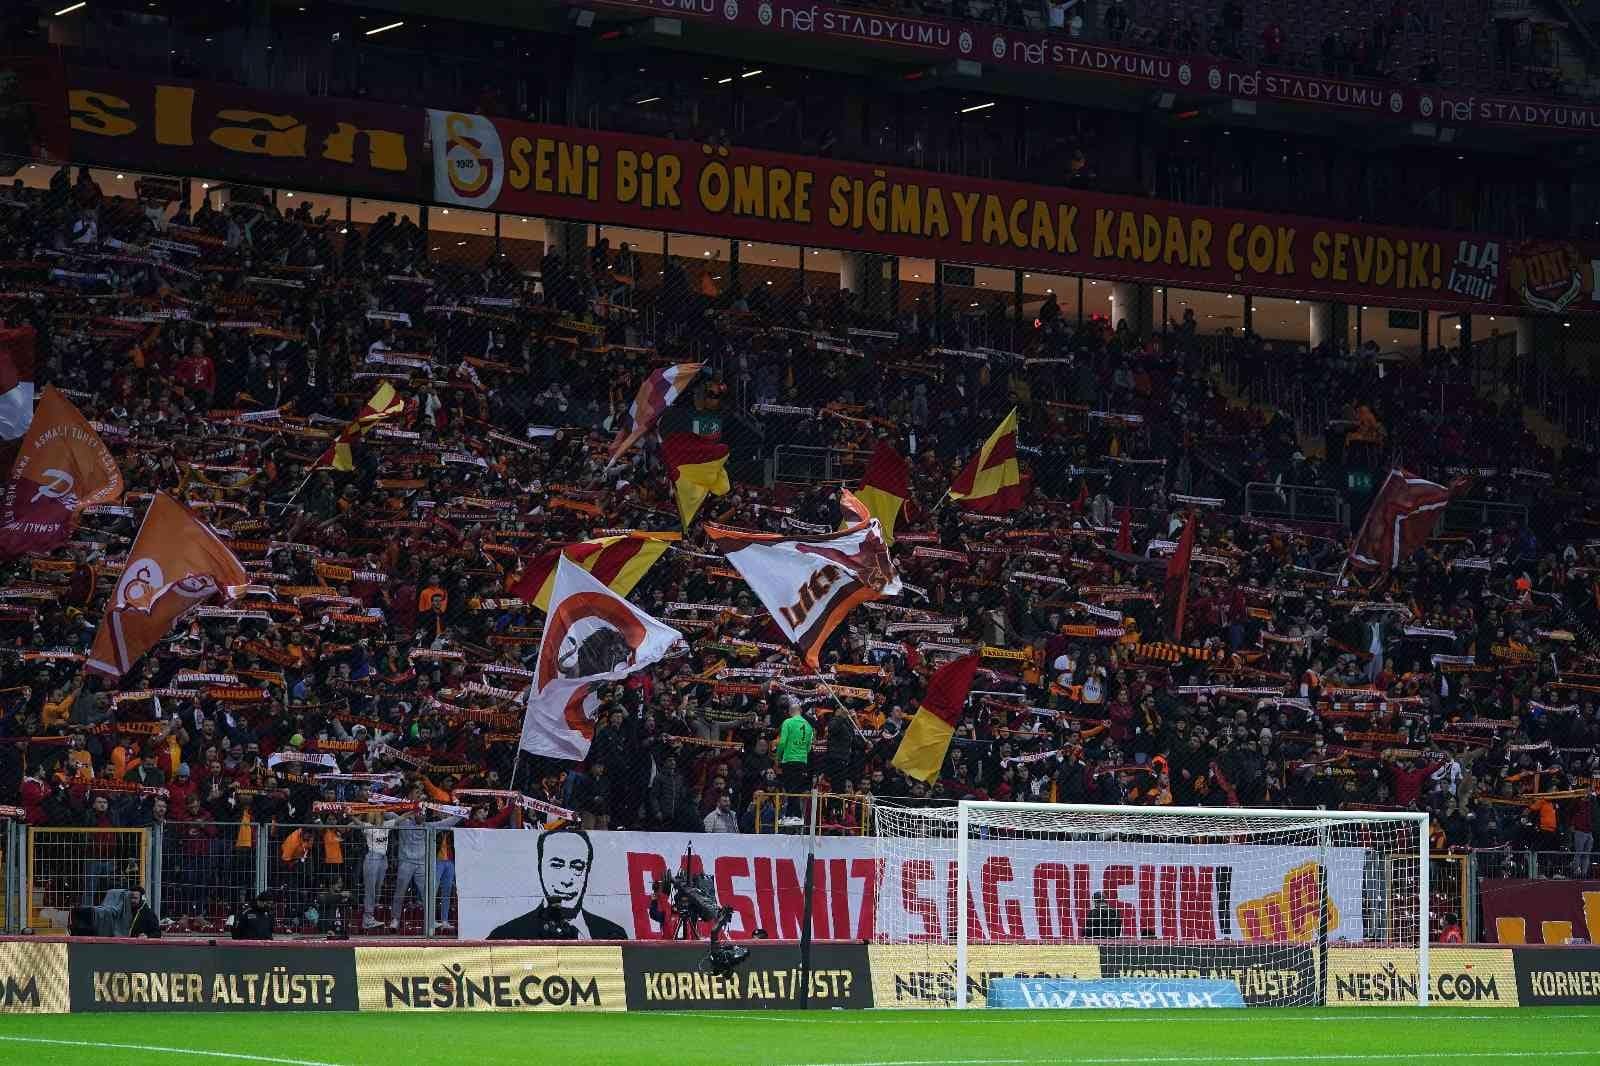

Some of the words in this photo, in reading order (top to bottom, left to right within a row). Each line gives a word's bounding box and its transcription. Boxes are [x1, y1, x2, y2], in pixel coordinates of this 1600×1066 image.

[780, 6, 818, 31] nef
[823, 11, 951, 46] STADYUMU
[1013, 39, 1048, 64] nef
[1053, 44, 1171, 78] STADYUMU
[1228, 70, 1262, 96] nef
[1266, 75, 1383, 106] STADYUMU
[1440, 97, 1475, 121] nef
[697, 143, 814, 223] ÖMRE
[1092, 210, 1213, 265] KADAR
[0, 976, 40, 1007] M
[93, 970, 204, 1003] KORNER
[211, 966, 336, 1006] ALT/ÜST?
[643, 970, 742, 1001] KORNER
[1335, 960, 1500, 1002] NESIN.COM
[1529, 970, 1600, 997] KORNER
[1081, 991, 1222, 1009] HOSPITAL
